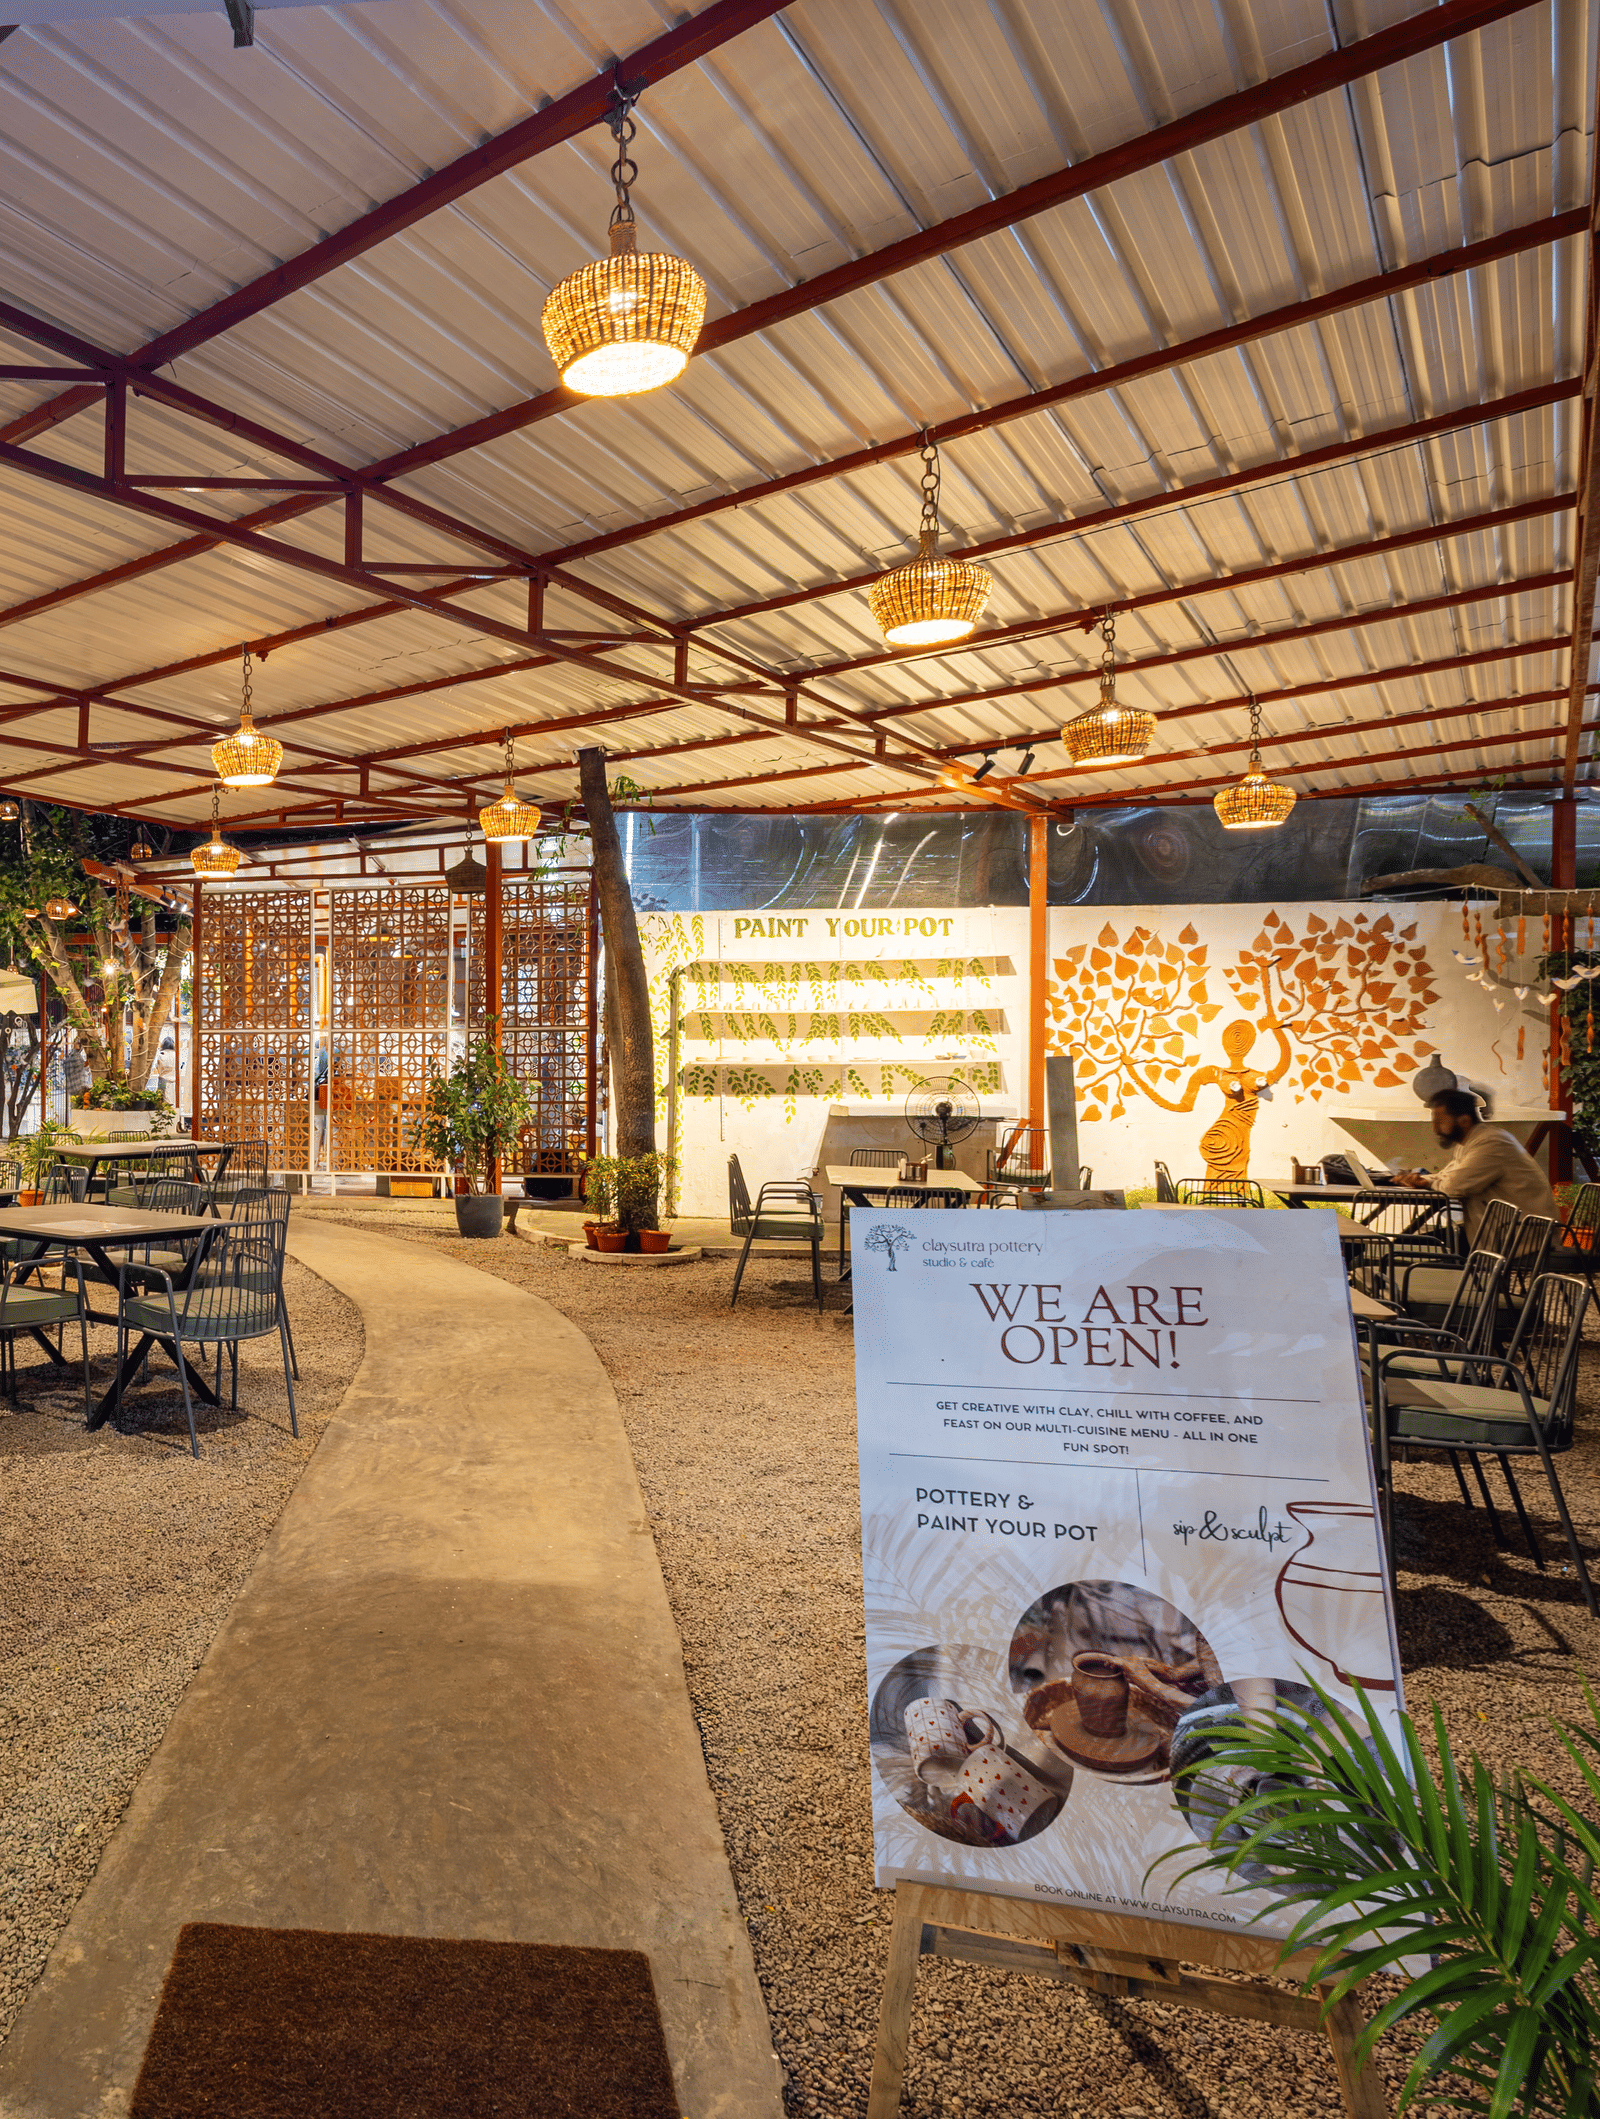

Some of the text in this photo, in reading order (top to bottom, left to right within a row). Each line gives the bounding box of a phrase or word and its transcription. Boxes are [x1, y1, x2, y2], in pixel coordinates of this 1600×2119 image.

[734, 917, 954, 939] PAINT YOUR POT
[922, 1239, 1043, 1256] claysutra pottery
[922, 1257, 956, 1268] studio
[959, 1257, 966, 1268] &
[969, 1283, 1209, 1327] WE ARE
[1000, 1325, 1180, 1370] OPEN!
[936, 1401, 1263, 1425] GET CREATIVE WITH CLAY, CHILL WITH COFFEE, AND
[943, 1419, 979, 1429] FEAST
[983, 1421, 1002, 1430] ON
[1005, 1422, 1031, 1432] OUR
[1035, 1424, 1127, 1437] MULTI-CUISINE
[1131, 1428, 1169, 1438] MENU
[1182, 1431, 1206, 1441] ALL
[1210, 1432, 1224, 1441] IN
[1228, 1433, 1258, 1444] ONE
[1063, 1443, 1129, 1455] FUN SPOT!
[916, 1488, 1034, 1510] POTTERY &
[918, 1514, 1098, 1542] PAINT YOUR POT
[1035, 1883, 1236, 1924] BOOK ONLINE AT WWW.CLAYSUTRA.COM
